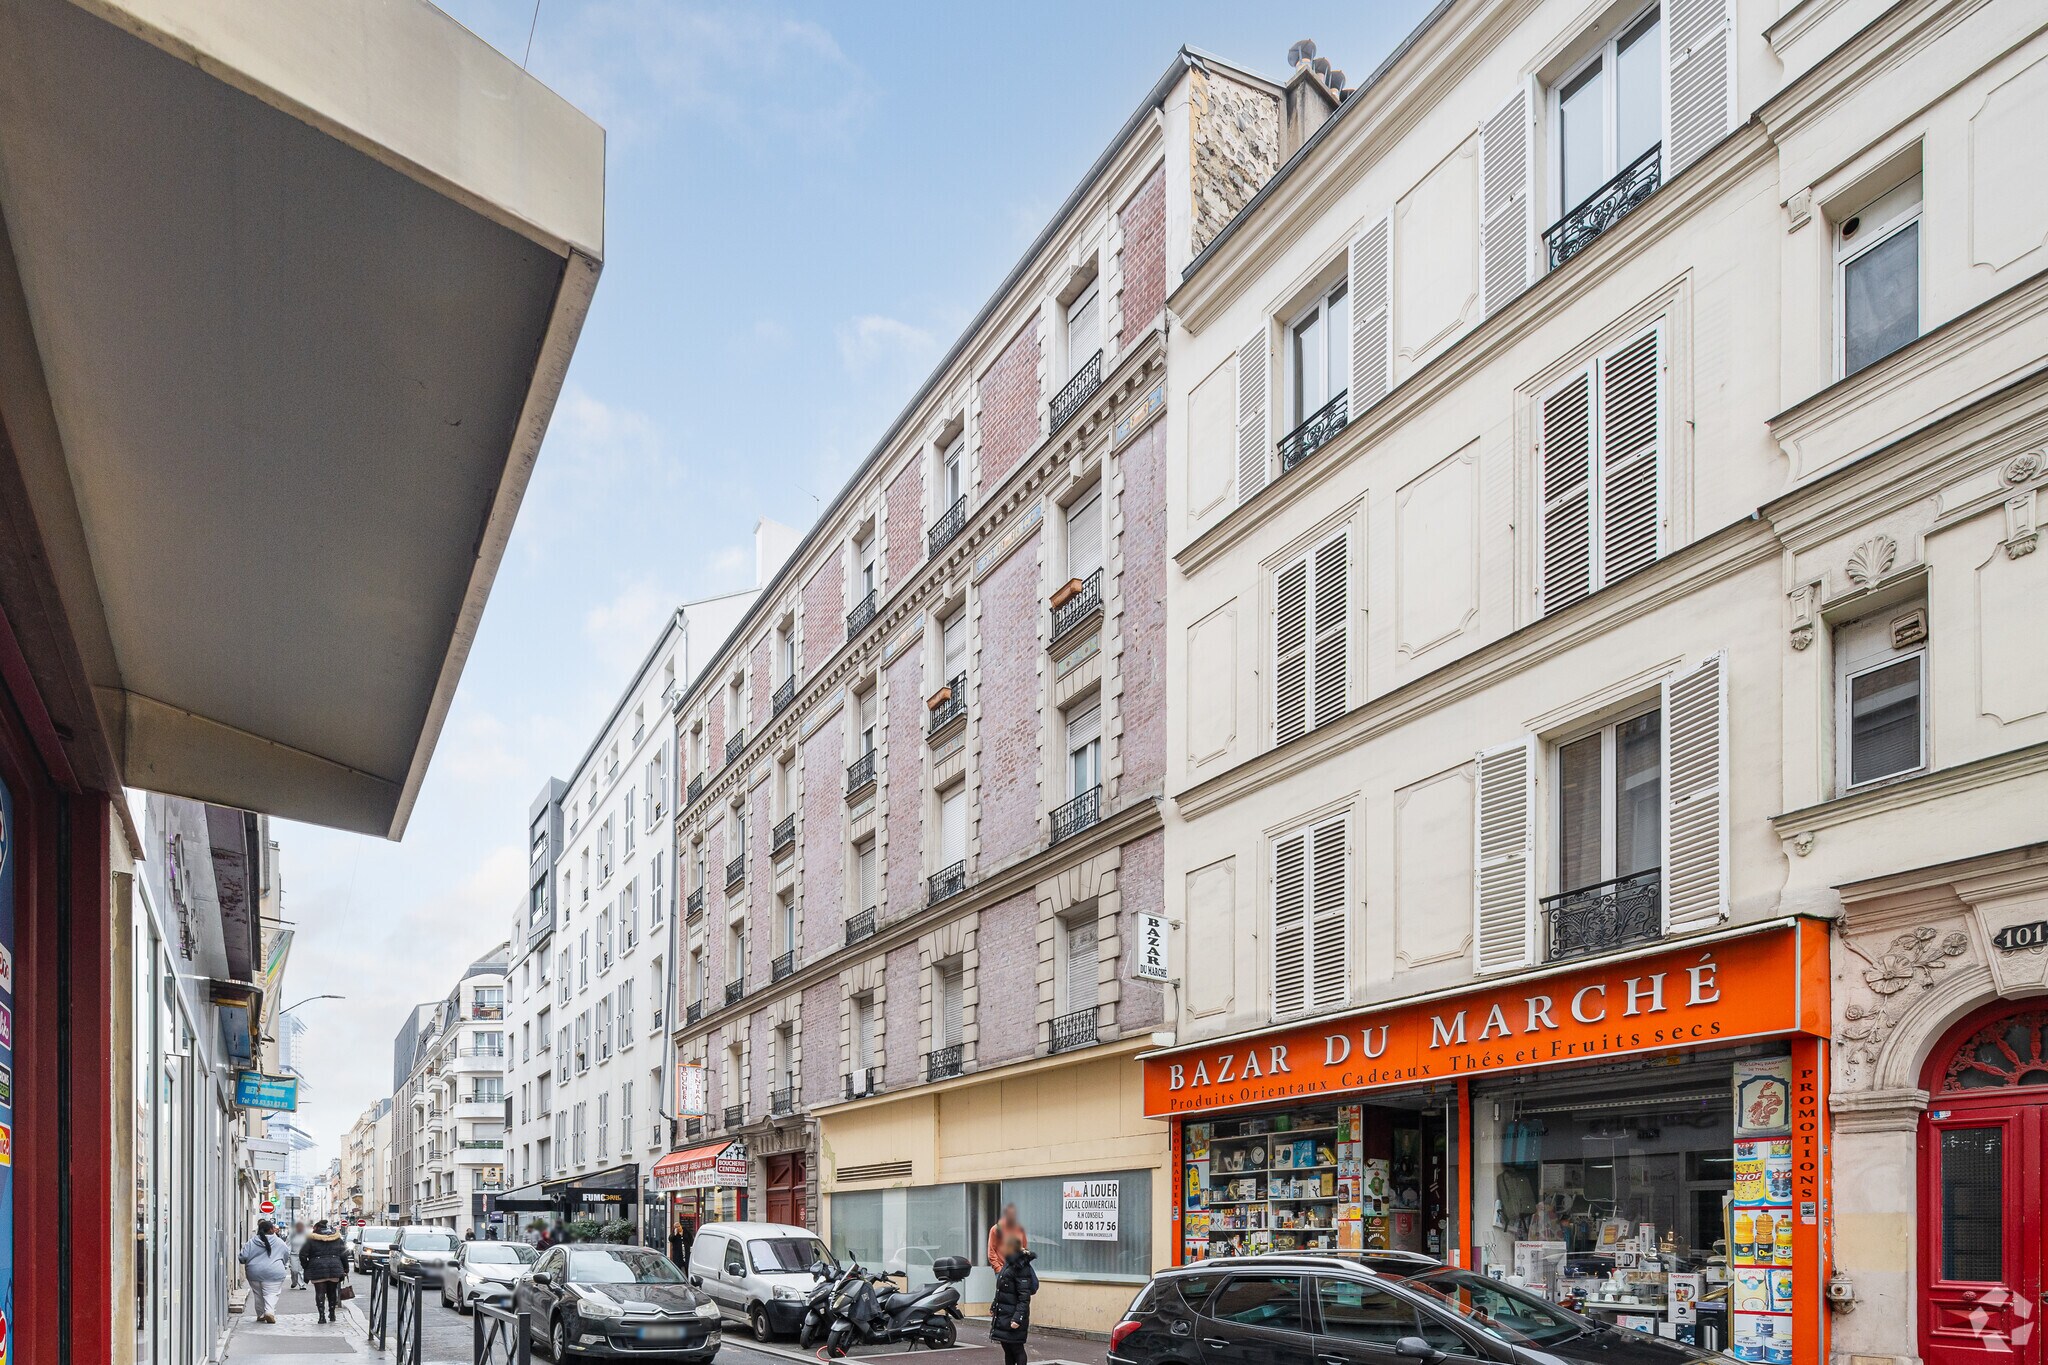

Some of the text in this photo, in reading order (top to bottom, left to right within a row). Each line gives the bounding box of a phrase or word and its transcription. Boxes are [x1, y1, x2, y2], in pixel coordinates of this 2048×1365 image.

[1147, 917, 1161, 966] BAZAR
[2003, 923, 2044, 948] 101
[1140, 964, 1168, 978] DU MARCHÉ
[1168, 952, 1722, 1092] BAZAR DU MARCHÉ
[1169, 1021, 1722, 1111] Produits Orientaux Cadeaux Thés et Fruits secs
[1797, 1069, 1816, 1198] PROMOTIONS
[1736, 1172, 1761, 1180] SIOF
[1082, 1182, 1118, 1198] À LOUER
[1065, 1200, 1117, 1210] LOCAL COMMERCIAL
[1064, 1221, 1116, 1230] 06 80 18 17 56
